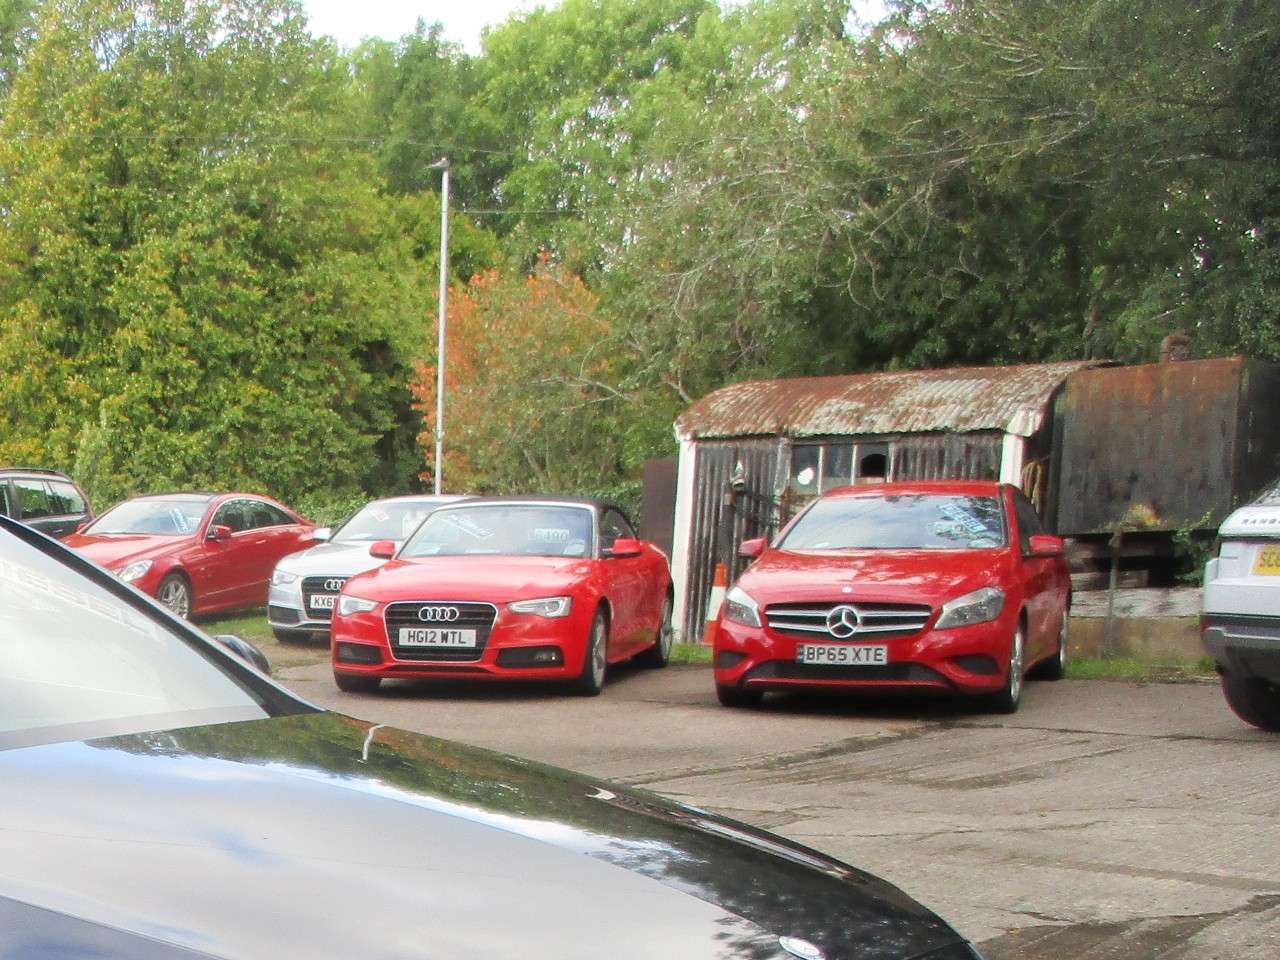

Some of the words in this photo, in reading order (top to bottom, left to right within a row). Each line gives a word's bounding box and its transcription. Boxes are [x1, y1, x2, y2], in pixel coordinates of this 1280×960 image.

[407, 630, 437, 644] HG12
[440, 631, 467, 645] WTL
[806, 646, 848, 662] BP65
[852, 647, 884, 662] XTE
